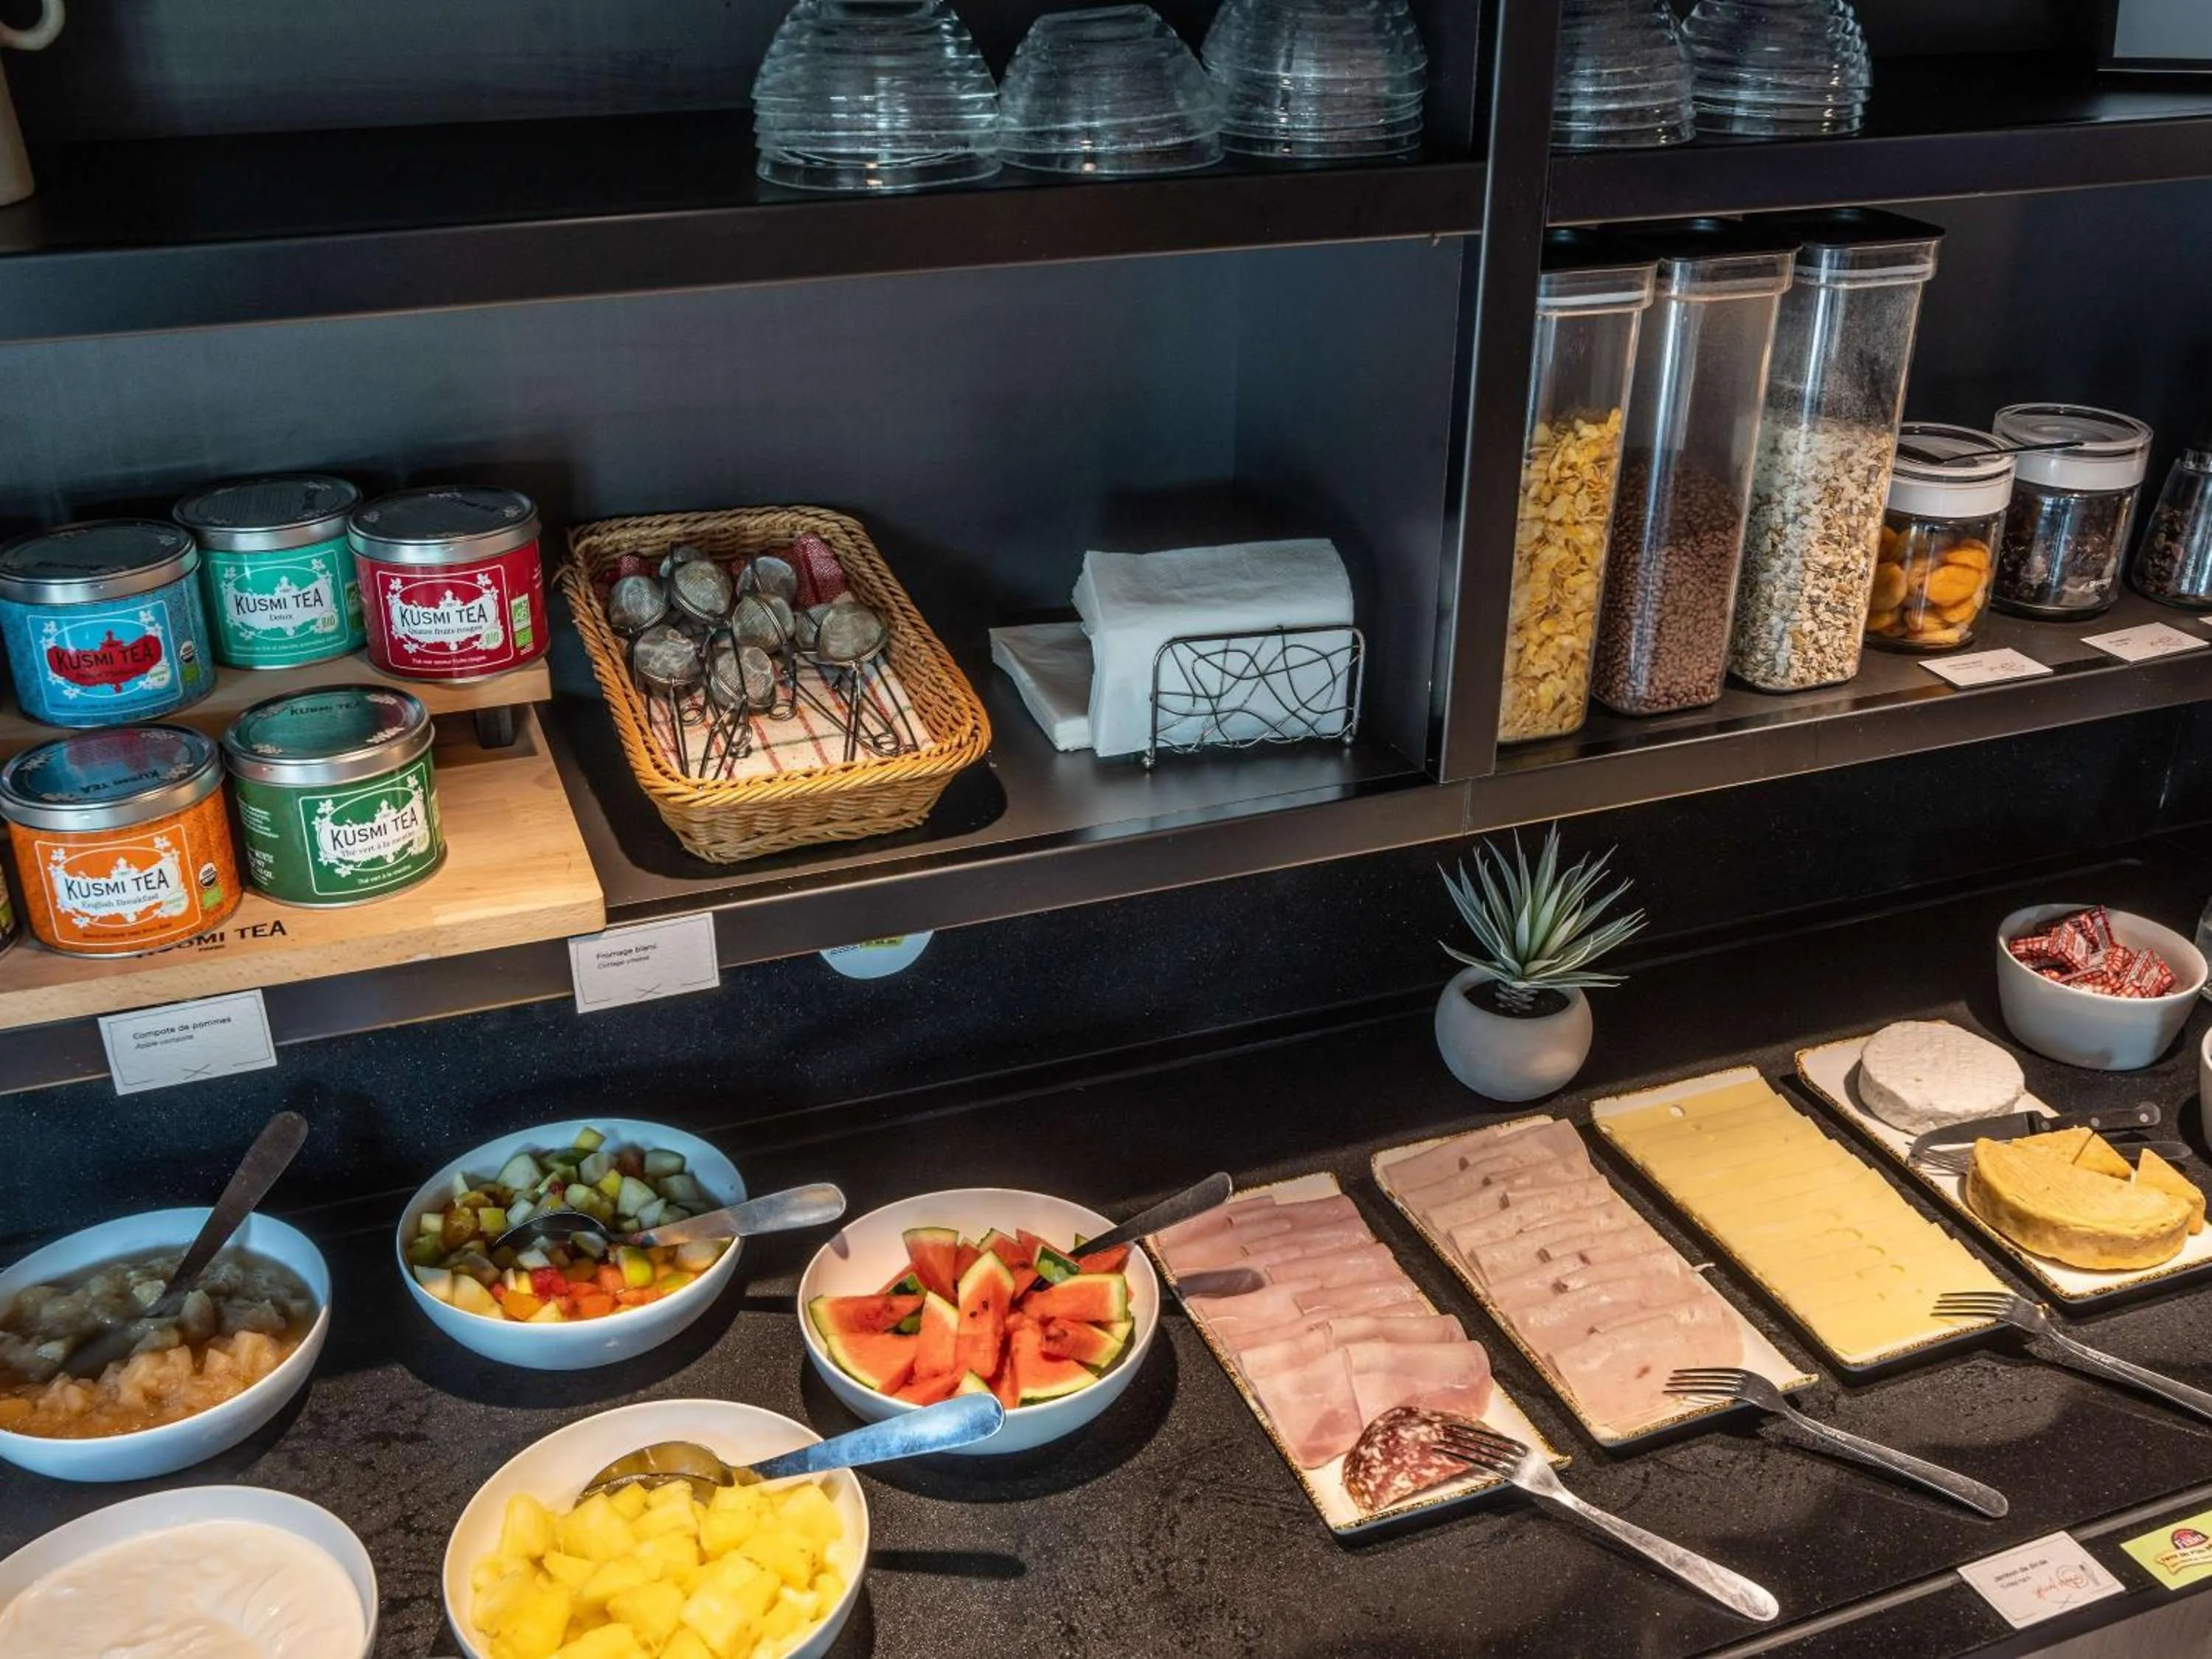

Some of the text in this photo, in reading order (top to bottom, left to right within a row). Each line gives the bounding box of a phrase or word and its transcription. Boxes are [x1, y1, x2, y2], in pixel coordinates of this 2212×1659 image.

[234, 588, 324, 616] KUSMI TEA
[399, 605, 451, 627] KUSMI
[455, 602, 487, 624] TEA
[484, 631, 500, 644] BIO
[56, 644, 153, 672] KUSMI TEA
[330, 821, 388, 851] KUSMI
[392, 806, 418, 832] TEA
[64, 868, 170, 901] KUSMI TEA
[81, 899, 114, 909] English
[116, 894, 159, 907] Breakfast
[234, 919, 288, 940] TEA
[132, 1026, 176, 1040] Compote
[192, 1016, 232, 1031] pommes
